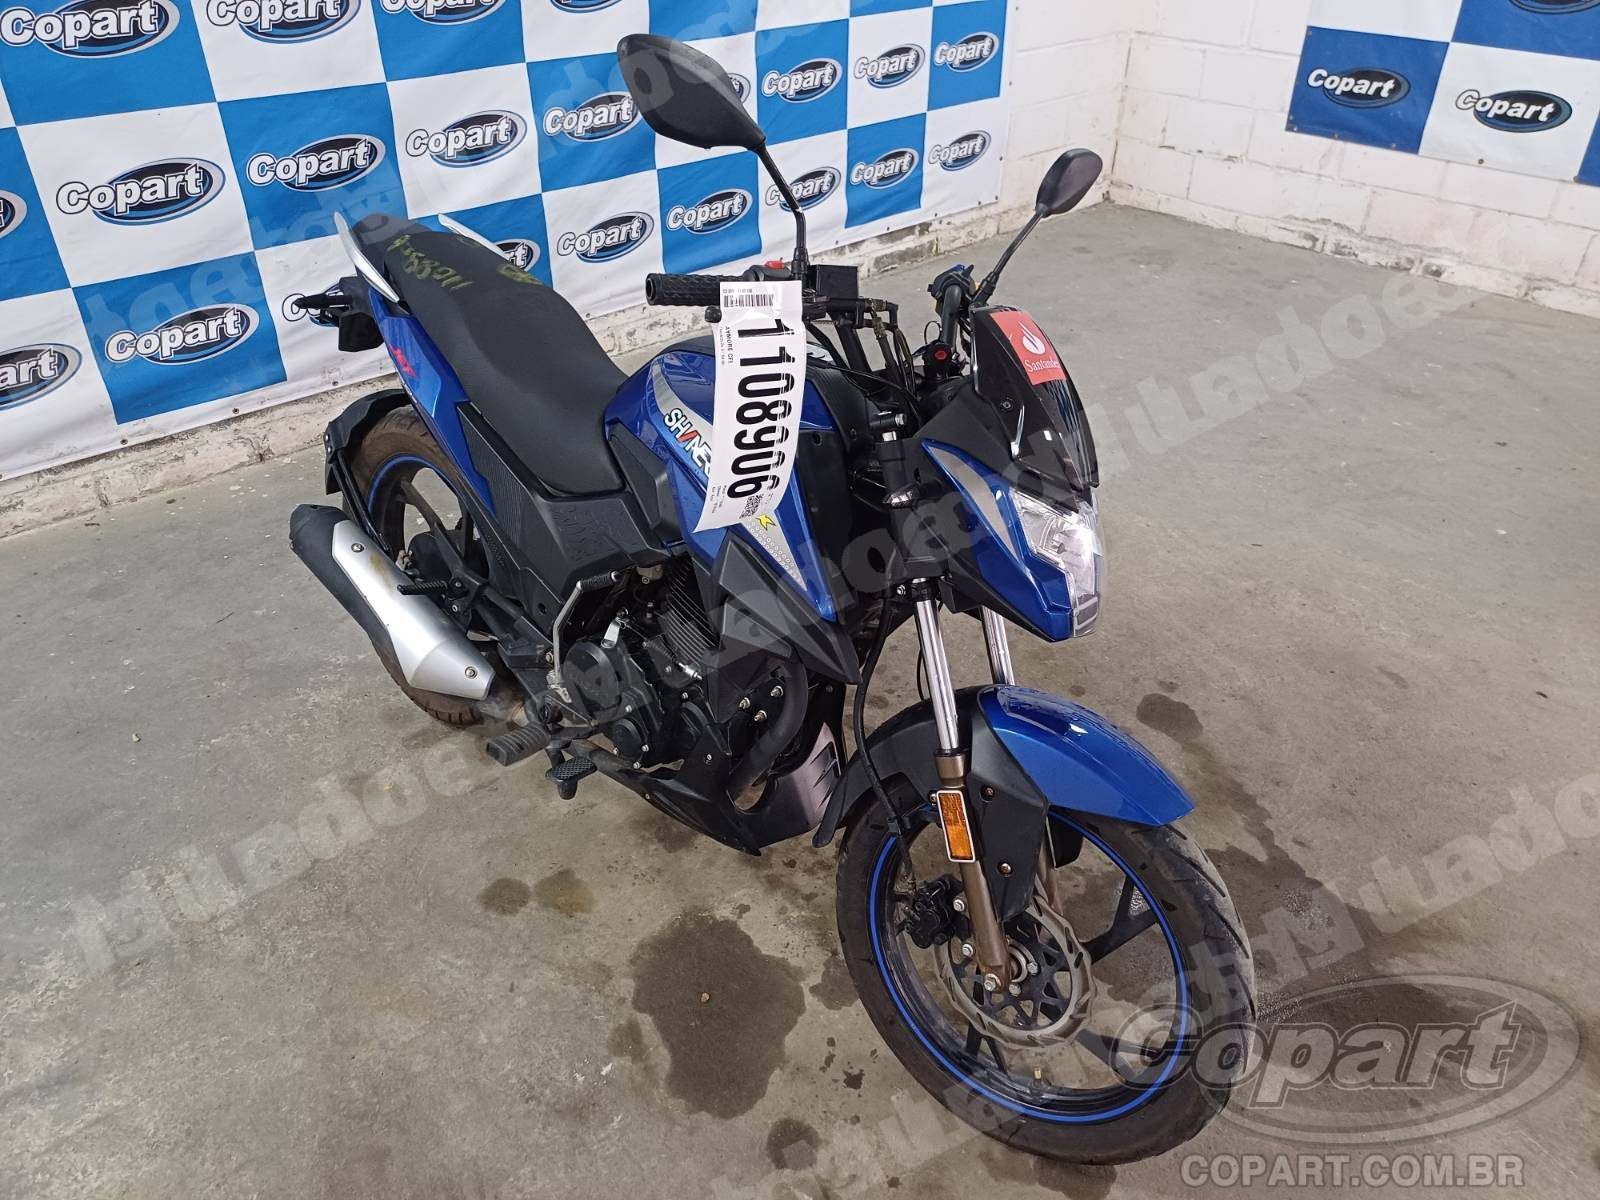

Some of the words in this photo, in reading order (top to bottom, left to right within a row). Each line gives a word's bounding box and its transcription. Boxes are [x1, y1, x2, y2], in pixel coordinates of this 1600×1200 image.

[0, 0, 159, 49] Copart
[854, 48, 917, 83] Copart
[934, 37, 992, 68] Copart
[762, 63, 834, 98] Copart
[1307, 68, 1397, 98] Copart
[544, 96, 633, 136] Copart
[1456, 89, 1556, 122] Copart
[406, 115, 512, 158] Copart
[928, 135, 984, 167] Copart
[247, 139, 370, 187] Copart
[850, 153, 912, 186] Copart
[56, 164, 203, 215] Copart
[765, 171, 833, 206] Cpart
[667, 192, 744, 230] Copart
[557, 217, 642, 257] Copart
[105, 307, 242, 362] Copart
[727, 319, 795, 498] 1108906
